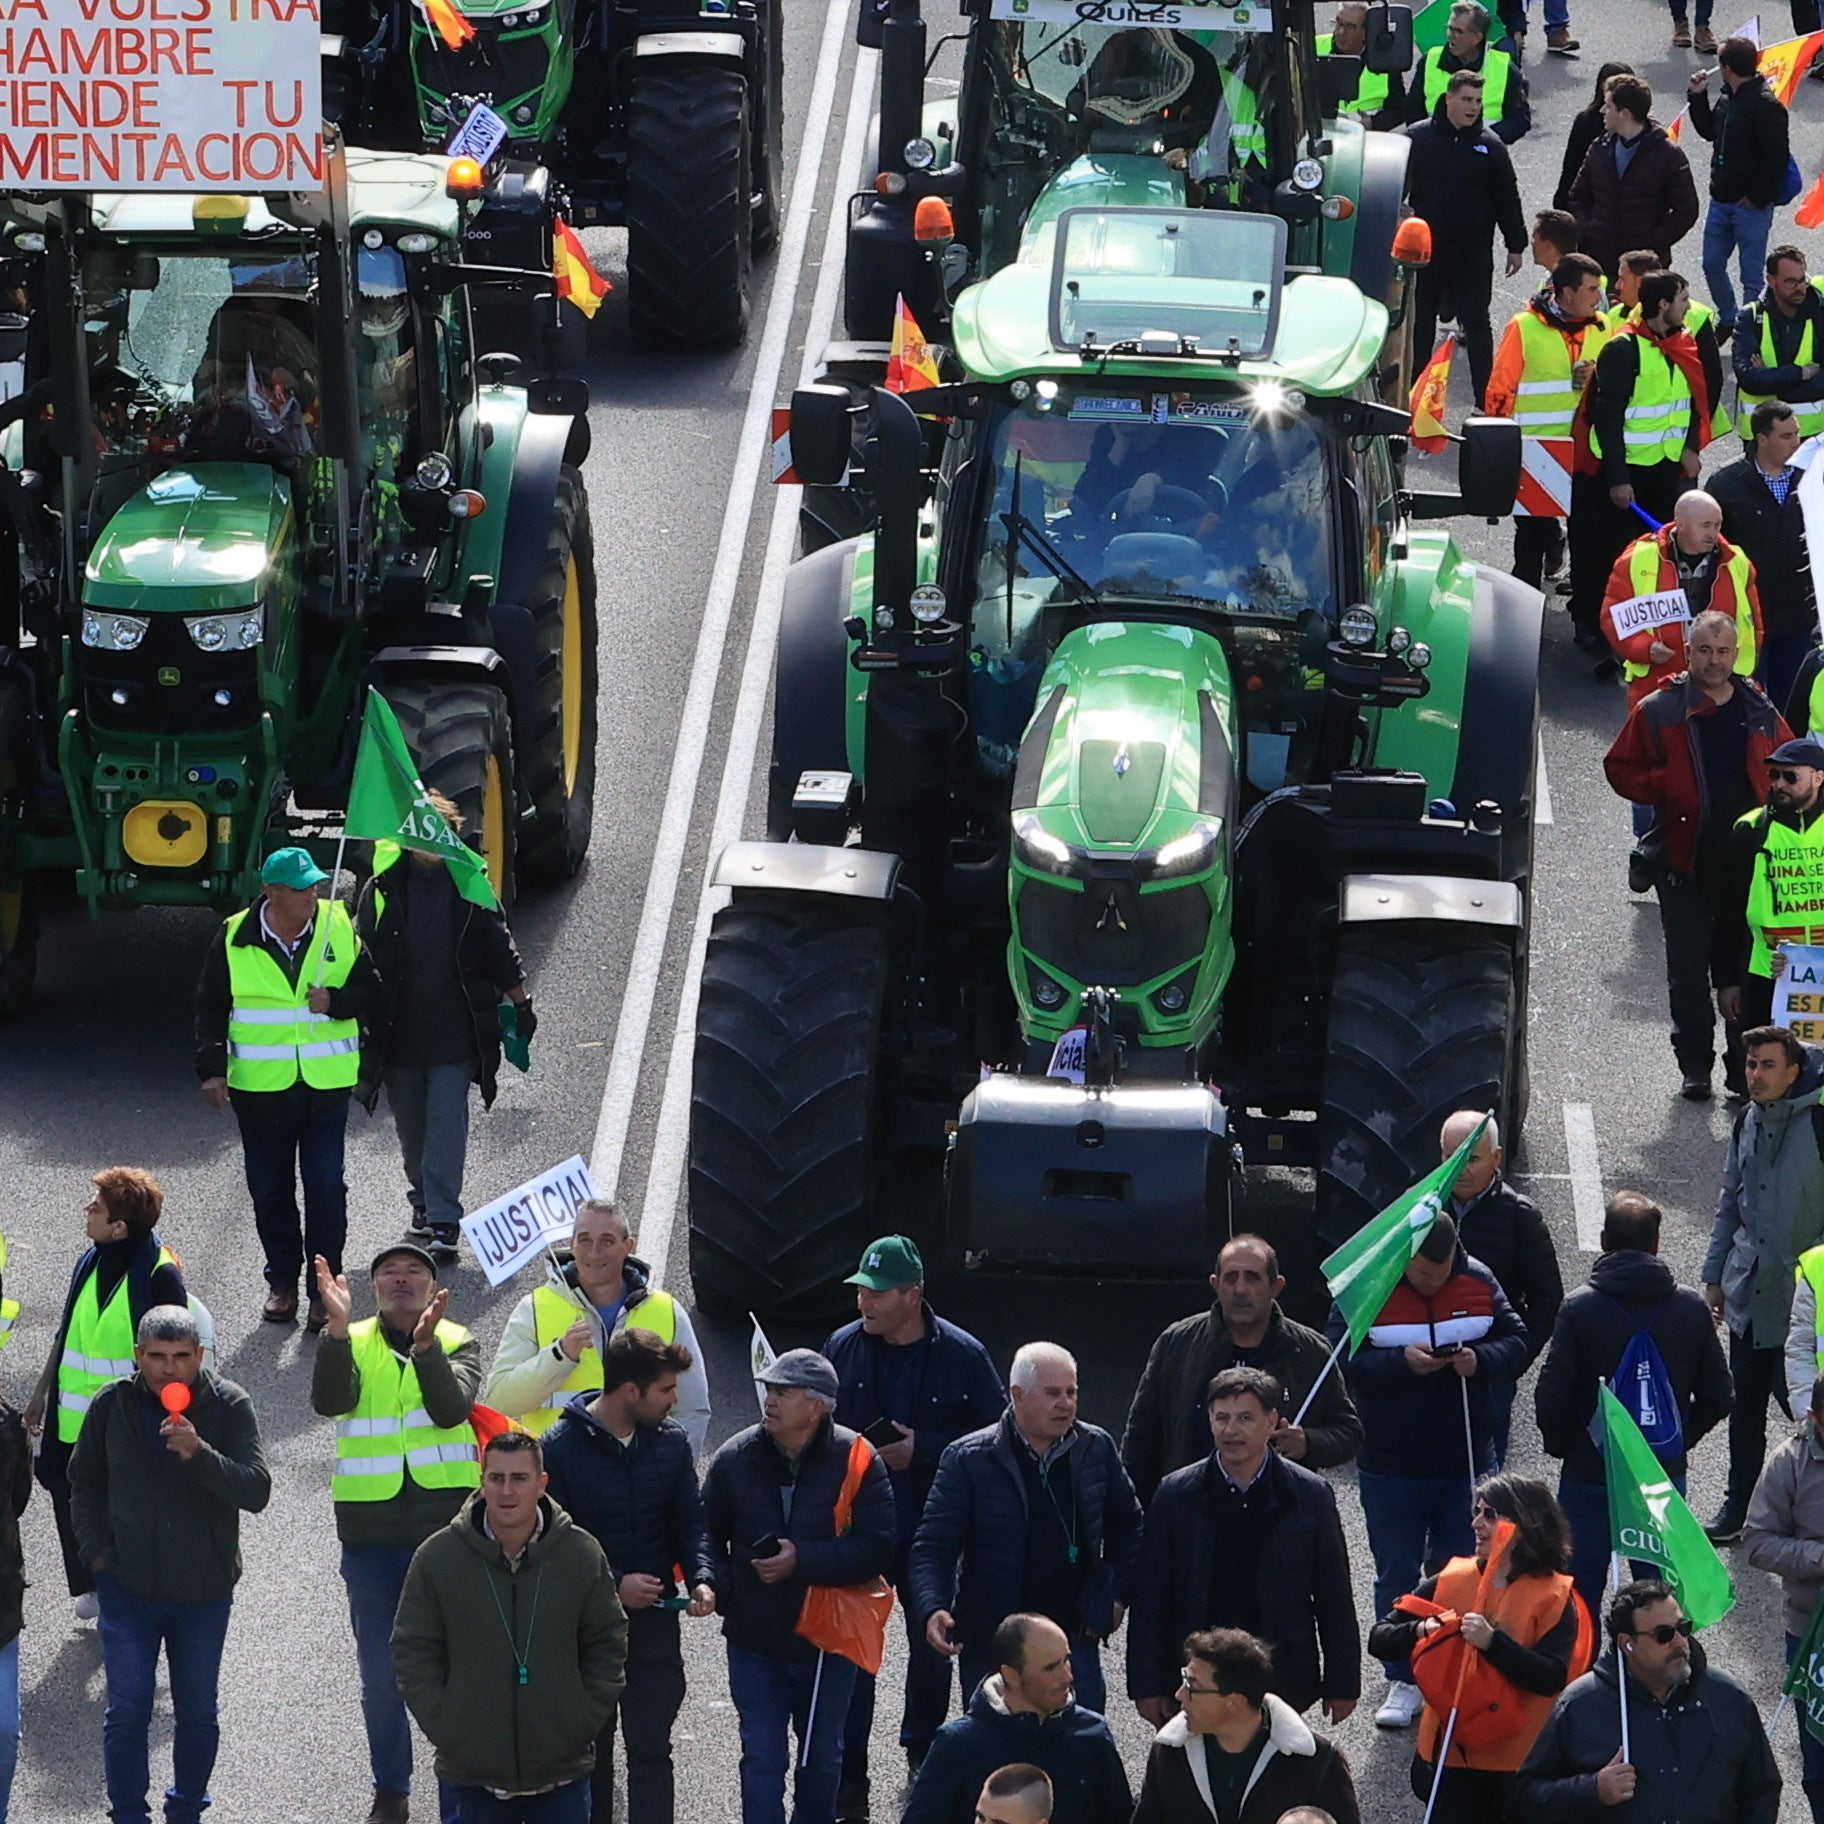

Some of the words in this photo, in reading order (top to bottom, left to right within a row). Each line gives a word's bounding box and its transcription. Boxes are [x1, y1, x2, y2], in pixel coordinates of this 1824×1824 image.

[1075, 2, 1181, 24] QUILES
[232, 80, 302, 127] TU
[1618, 595, 1685, 629] ¡JUSTICIA!
[1790, 965, 1817, 985] LA
[1786, 996, 1813, 1014] ES
[1790, 1021, 1816, 1040] SE
[477, 1167, 595, 1268] ¡JUSTICIA!
